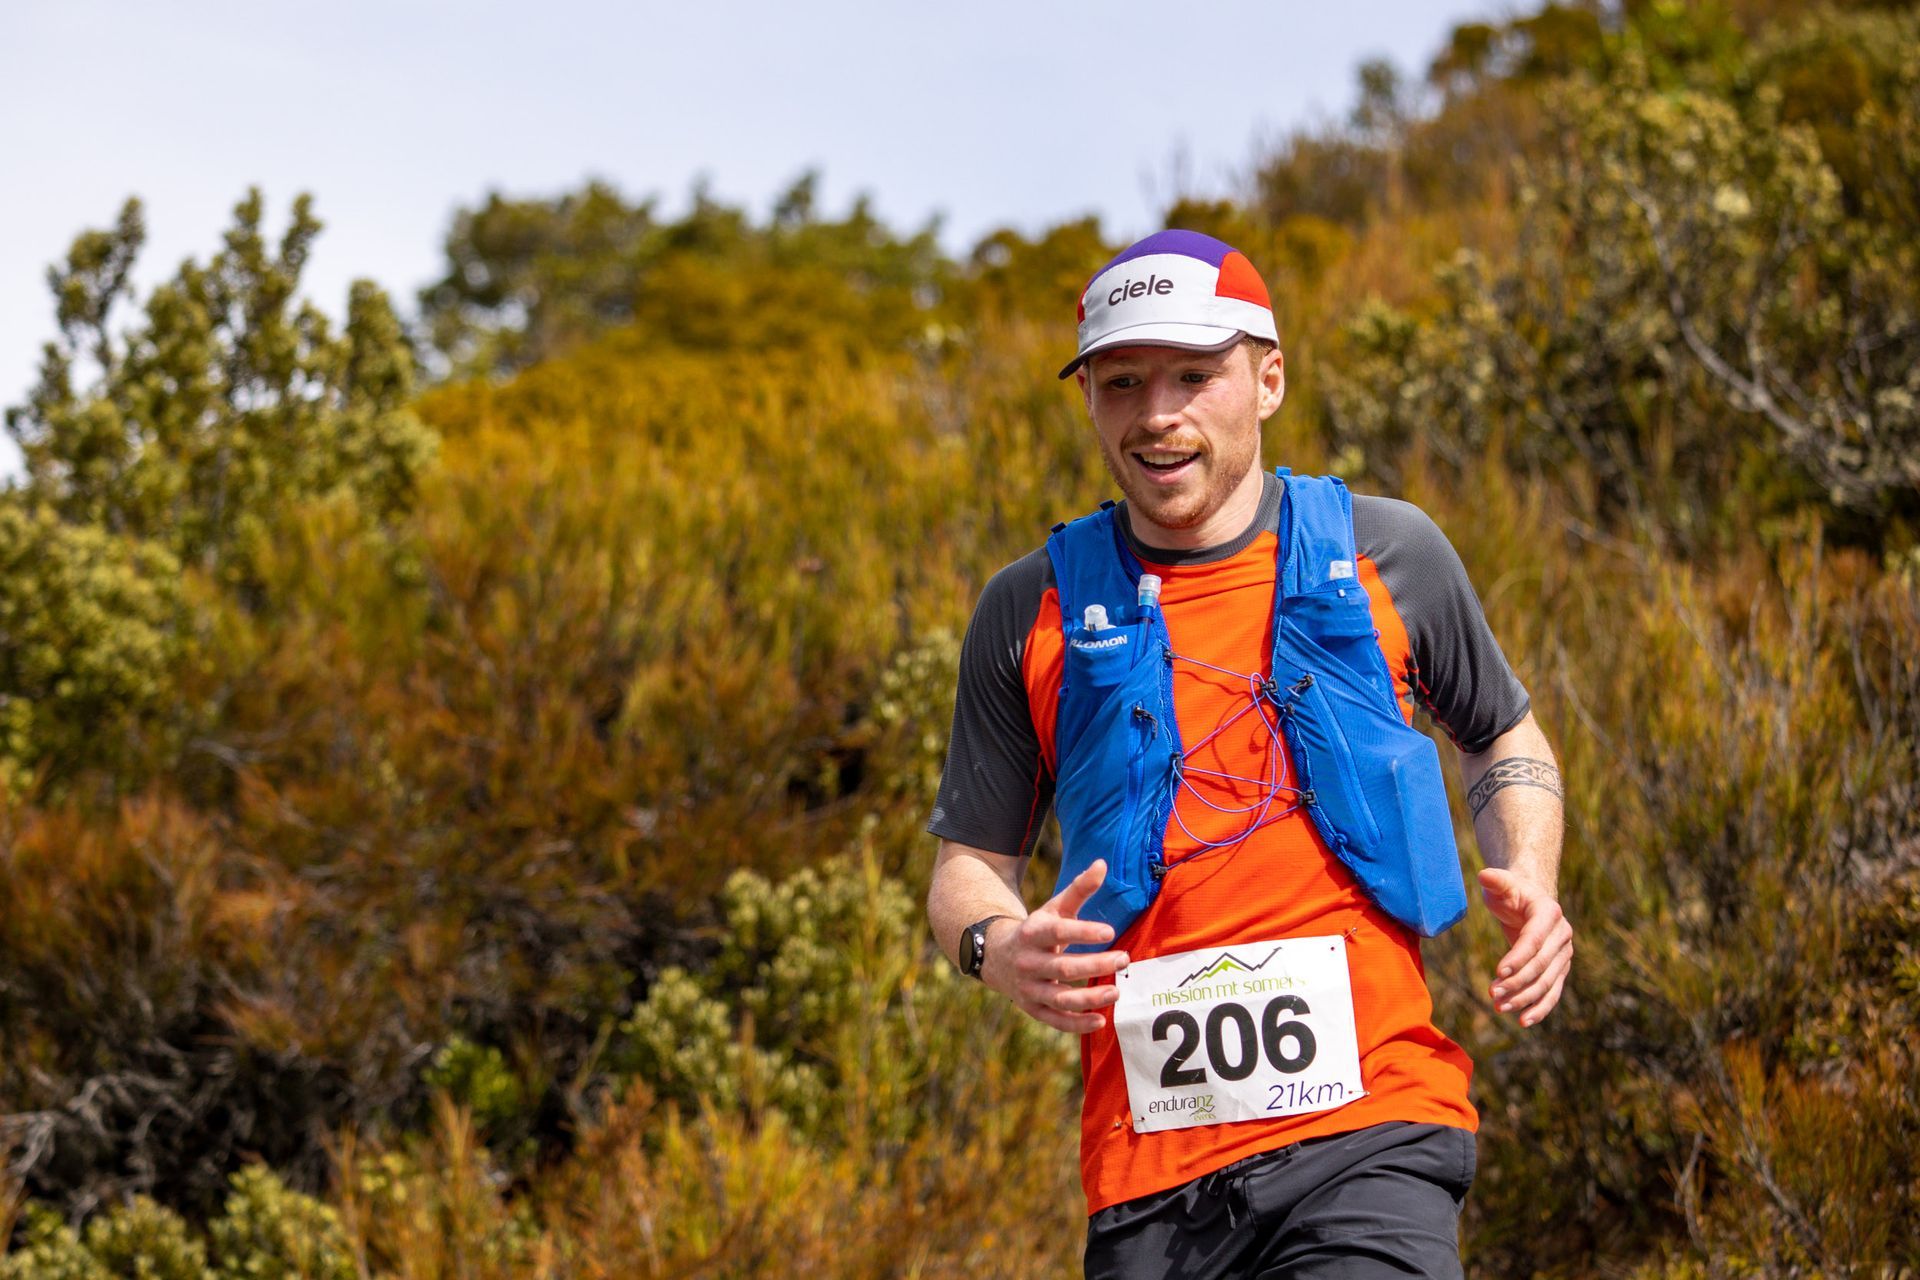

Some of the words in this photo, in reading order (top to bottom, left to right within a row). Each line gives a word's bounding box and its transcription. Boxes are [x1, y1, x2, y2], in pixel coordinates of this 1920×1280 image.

[1108, 274, 1174, 306] ciele
[1069, 634, 1127, 649] ALOMON
[1152, 984, 1213, 1007] mission
[1216, 981, 1238, 999] mt
[1151, 994, 1317, 1088] 206
[1148, 1094, 1214, 1113] enduranz
[1266, 1080, 1344, 1110] 21km
